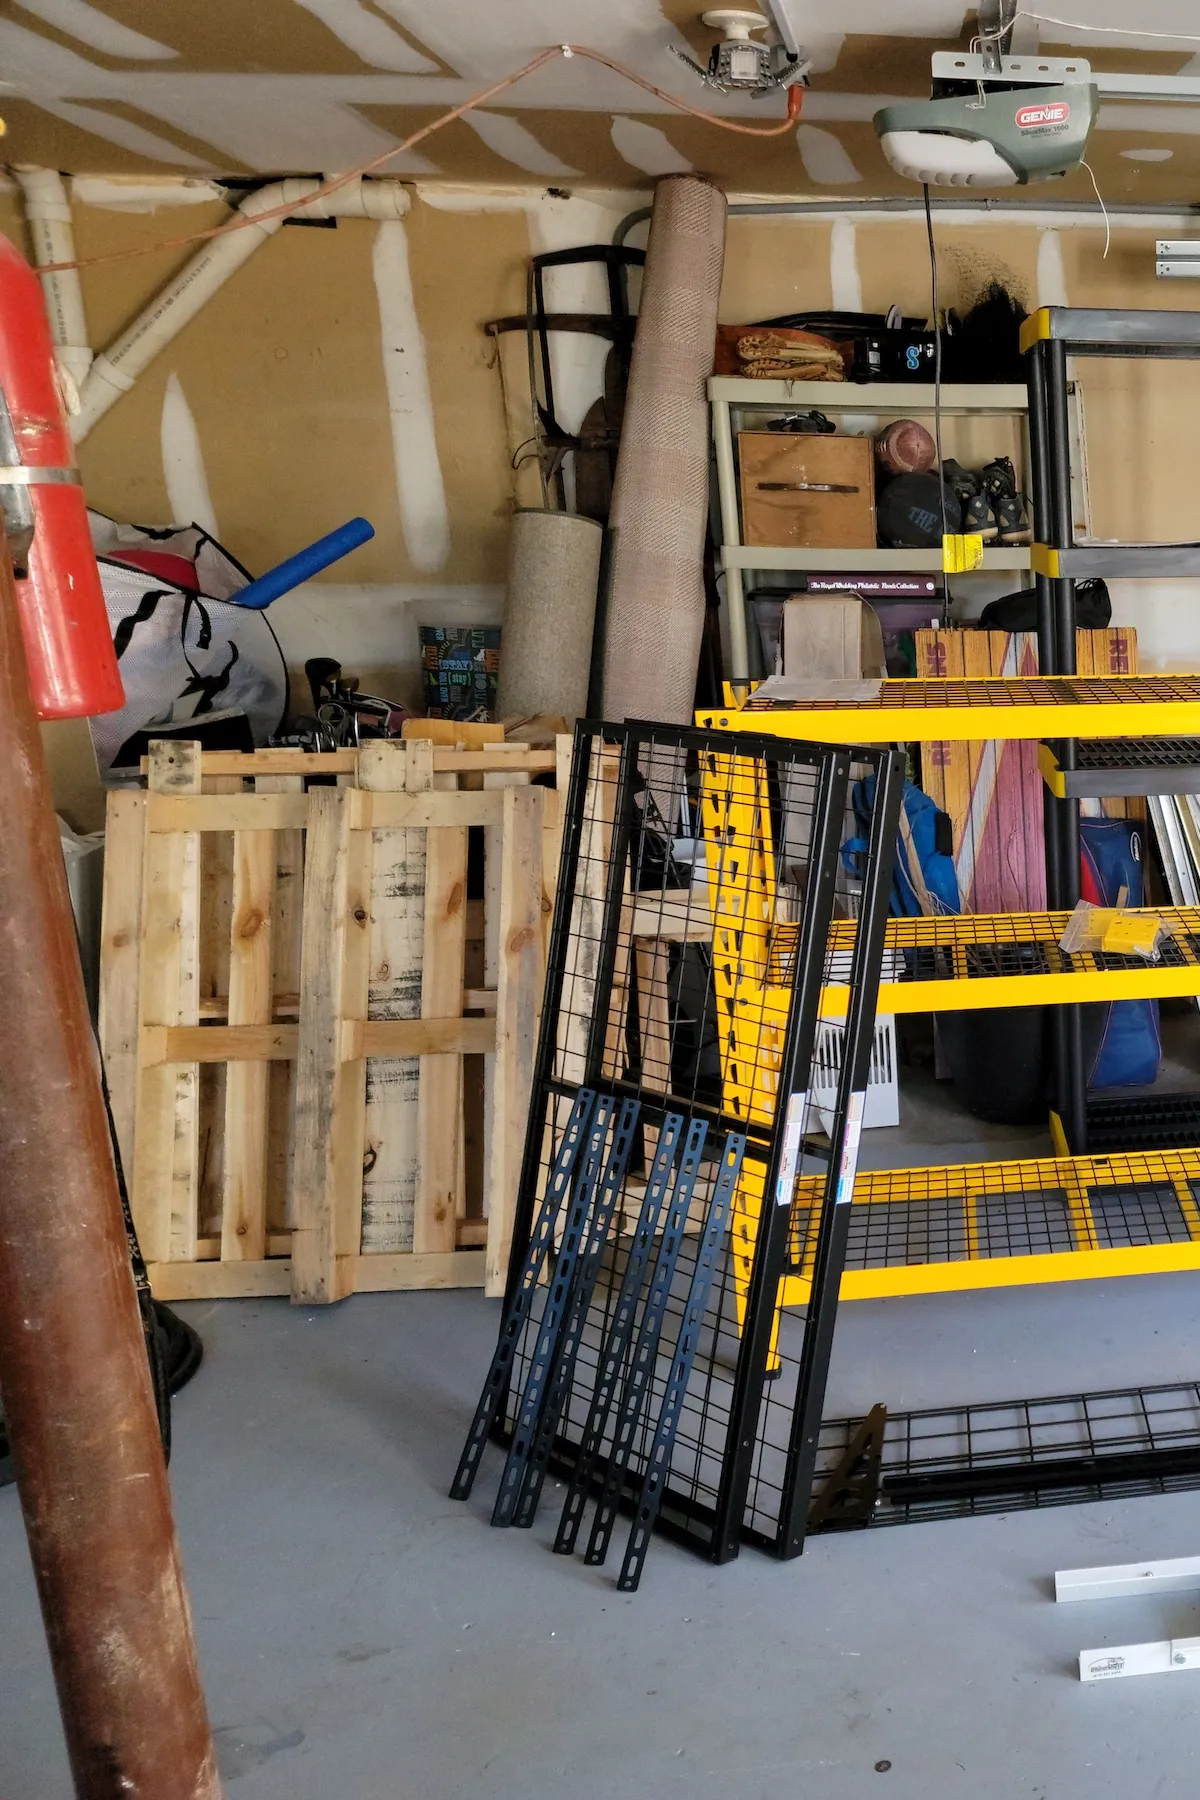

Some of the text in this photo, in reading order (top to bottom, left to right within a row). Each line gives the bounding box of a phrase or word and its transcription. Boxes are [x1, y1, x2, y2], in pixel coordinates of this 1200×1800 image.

[1020, 107, 1064, 123] GENIE
[820, 581, 835, 590] Royal
[835, 581, 857, 590] Wedding
